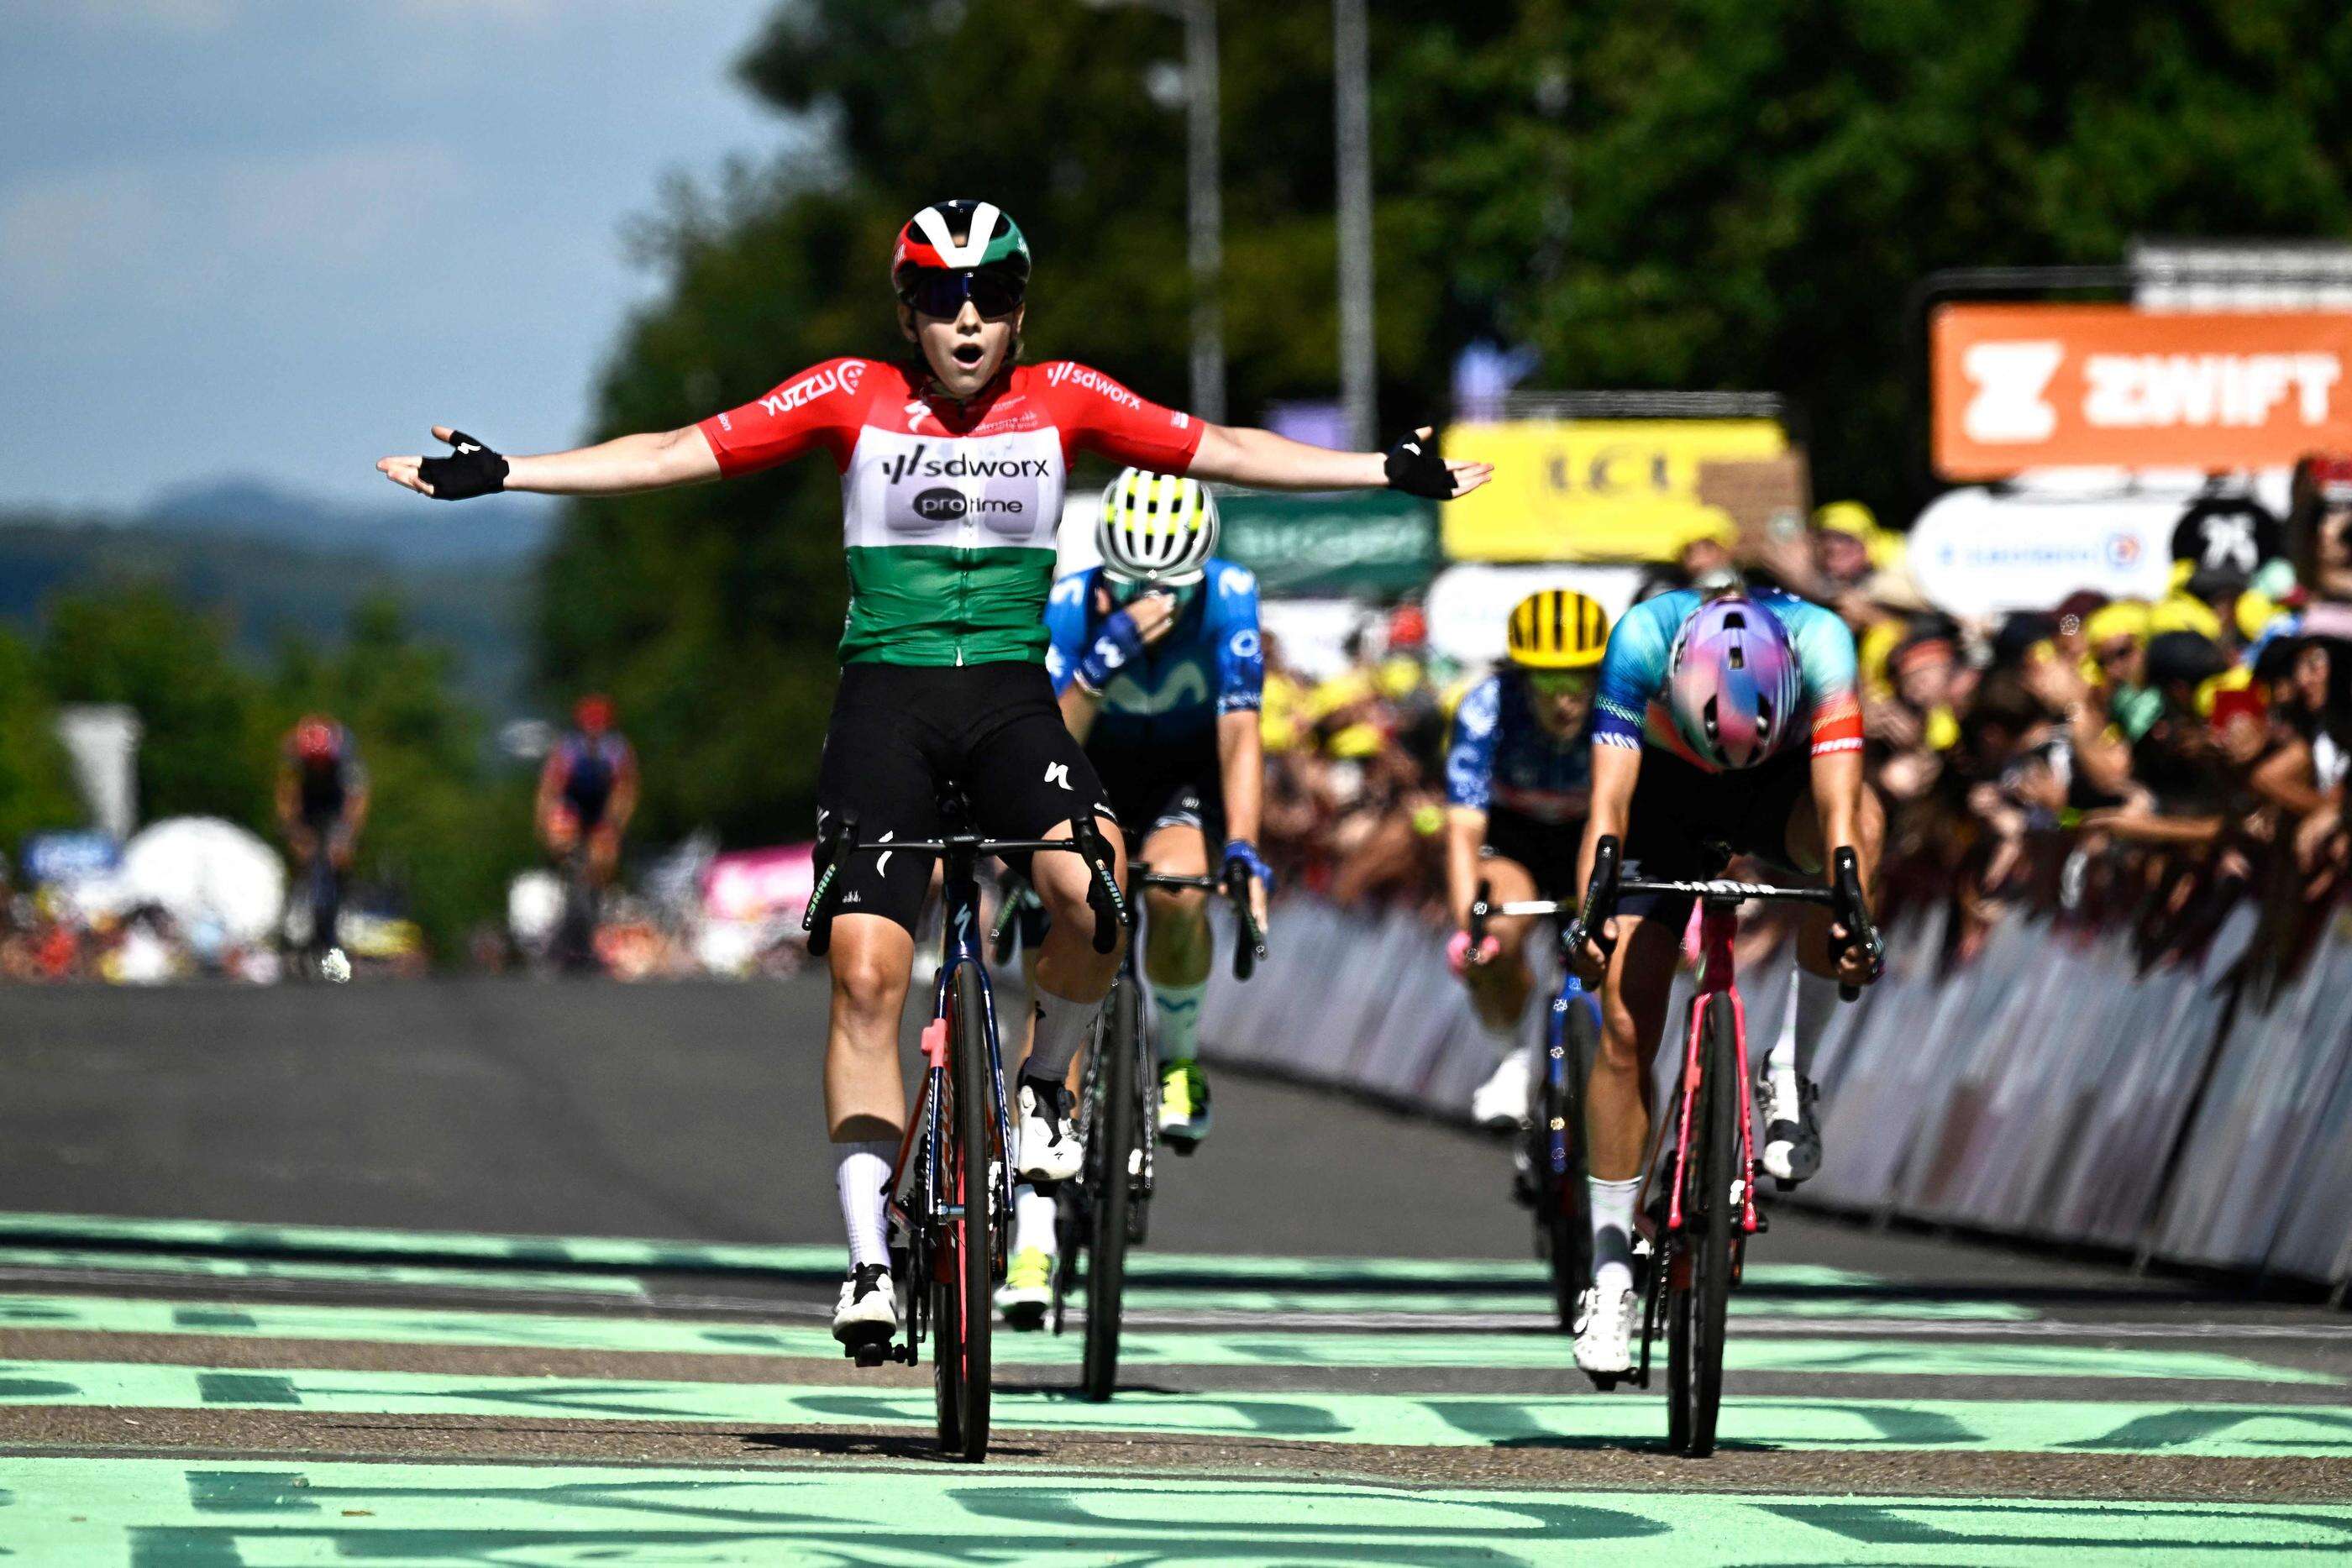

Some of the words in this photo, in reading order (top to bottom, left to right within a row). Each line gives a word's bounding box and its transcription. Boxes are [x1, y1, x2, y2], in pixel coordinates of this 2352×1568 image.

[758, 370, 837, 417] YUZZU
[2083, 354, 2342, 427] ZWIFT
[921, 496, 1023, 514] protime
[1095, 858, 1124, 909] SRAM
